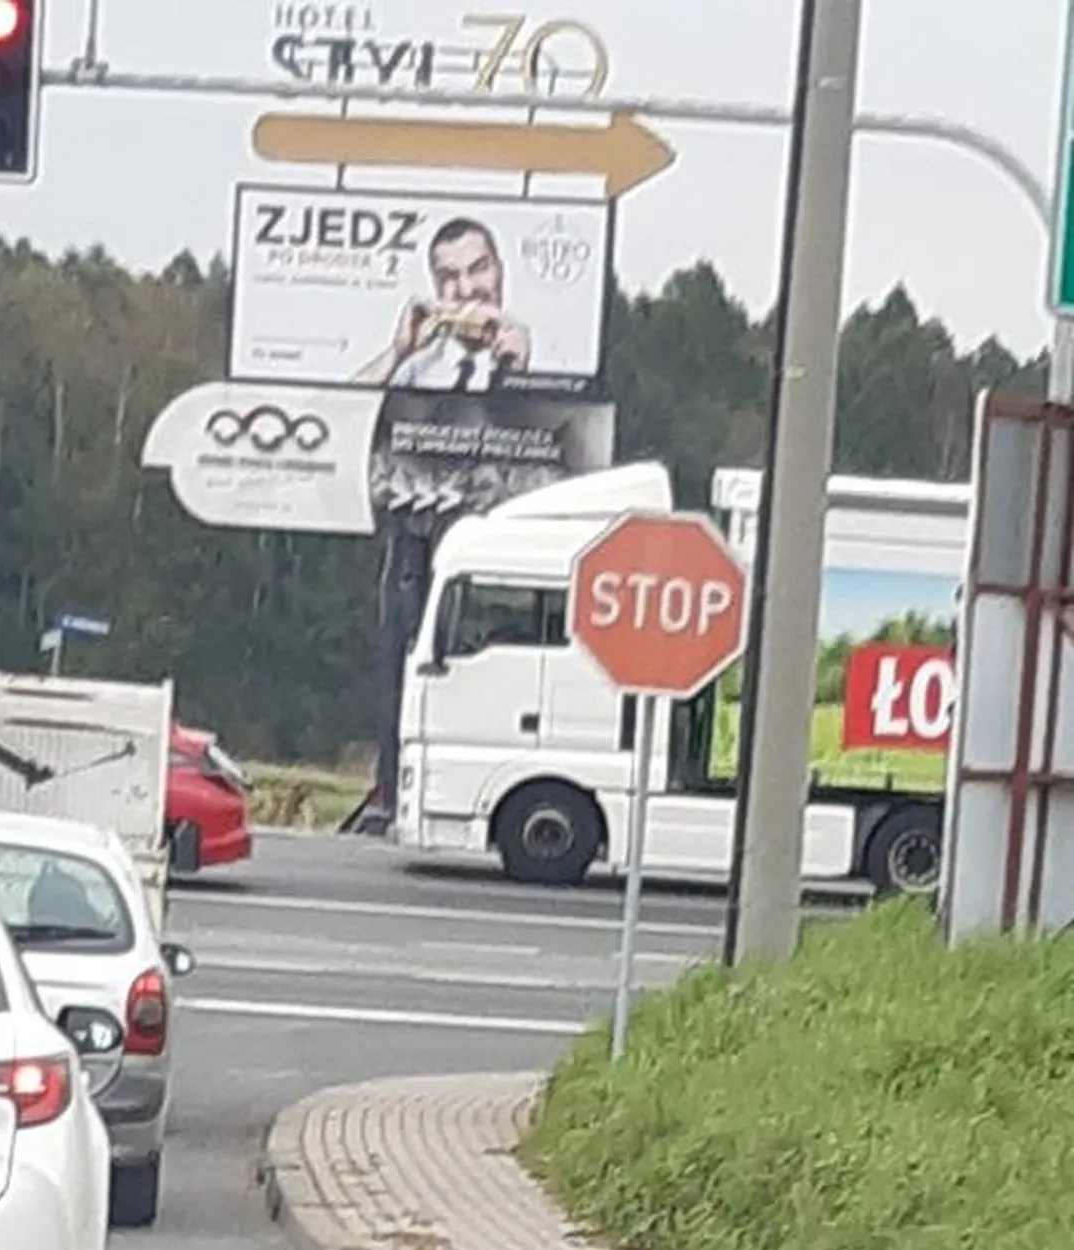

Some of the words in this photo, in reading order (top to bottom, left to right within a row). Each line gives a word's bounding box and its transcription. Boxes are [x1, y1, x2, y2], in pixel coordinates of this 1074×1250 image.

[462, 14, 608, 98] 70
[590, 571, 731, 636] STOP
[871, 656, 956, 740] ŁO
